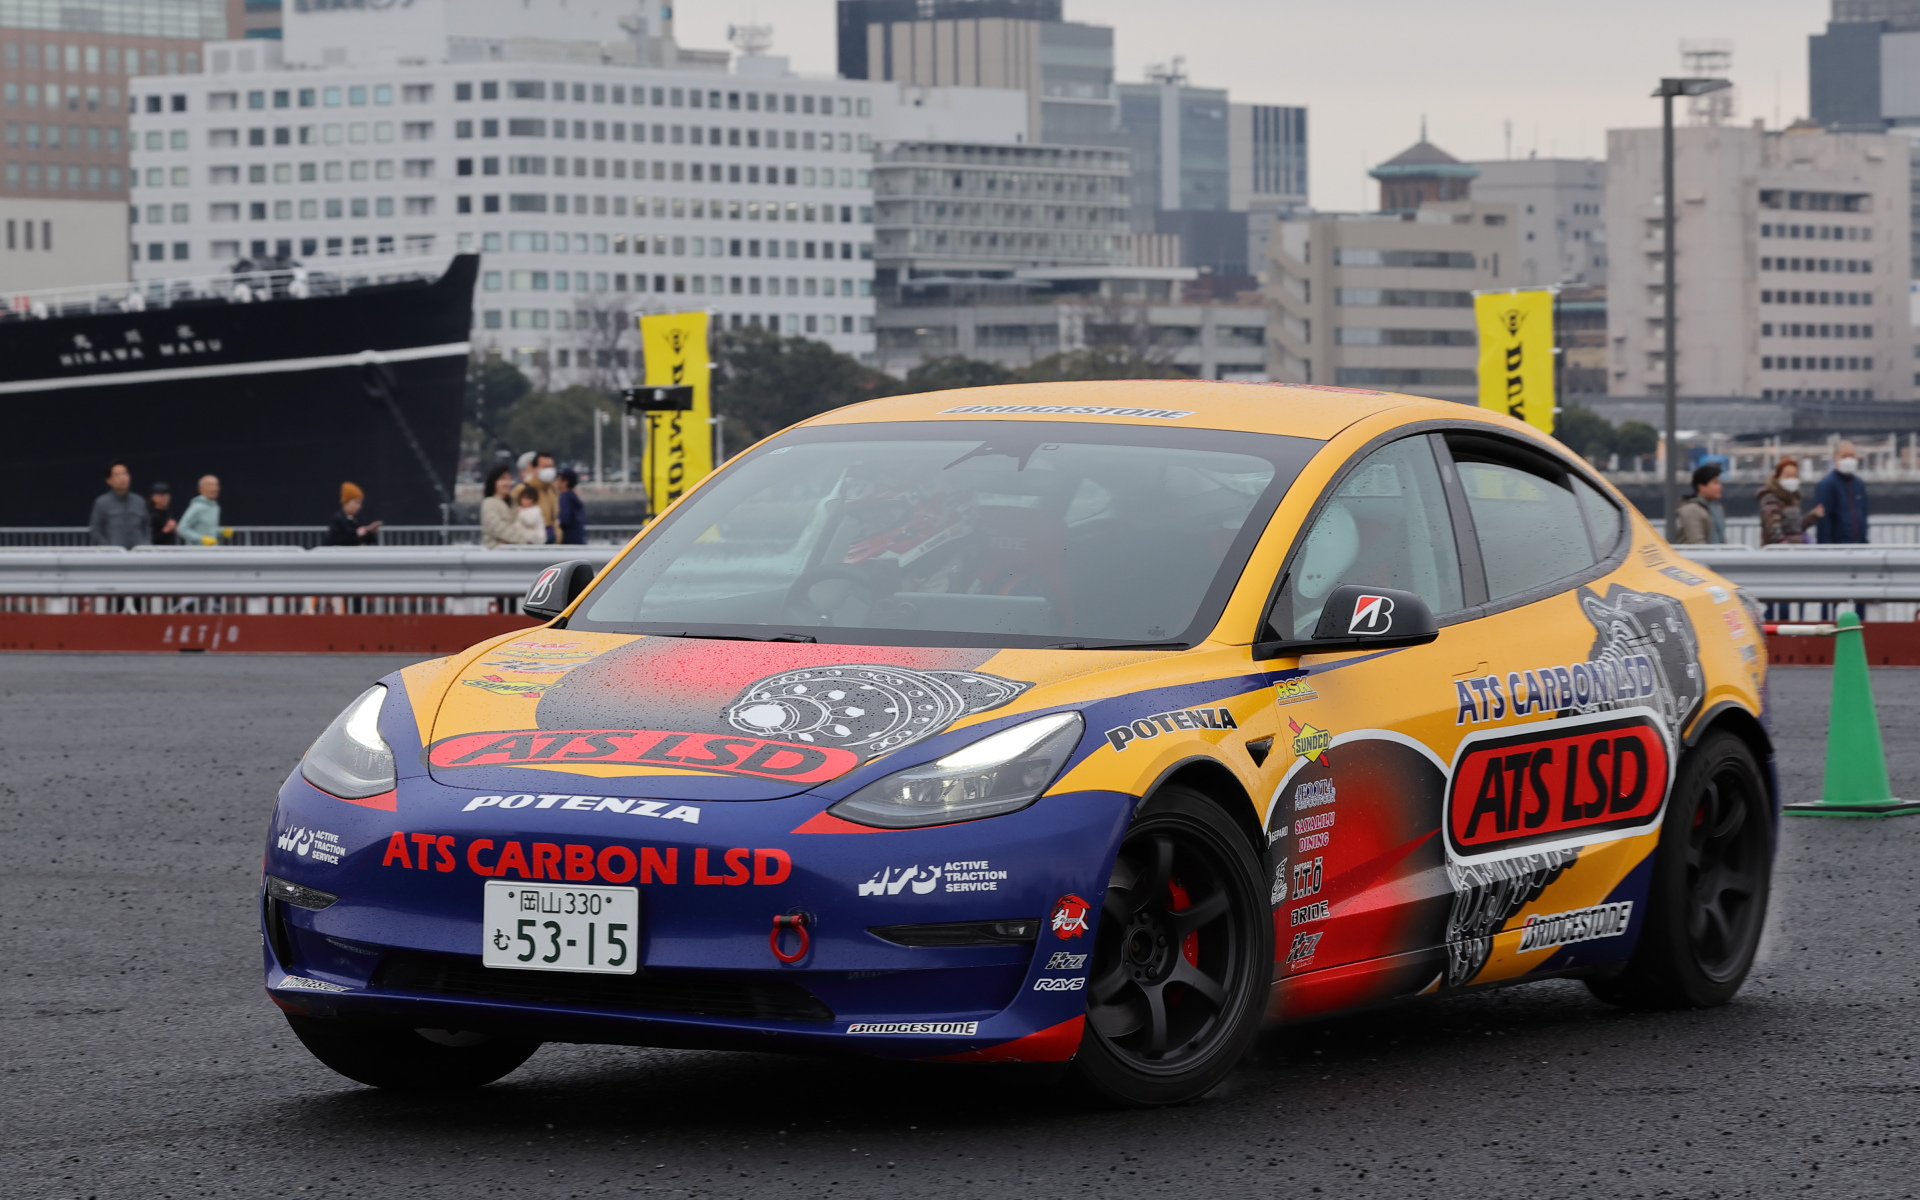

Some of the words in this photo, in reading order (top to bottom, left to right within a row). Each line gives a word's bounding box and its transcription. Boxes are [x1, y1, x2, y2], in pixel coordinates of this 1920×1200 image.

[946, 404, 1189, 419] BRIDGESTONE
[1273, 676, 1313, 698] RSK
[1454, 675, 1506, 726] ATS
[1508, 661, 1608, 717] CARBON
[1614, 655, 1655, 702] LSD
[1105, 708, 1239, 752] POTENZA
[450, 731, 635, 766] ATS
[637, 733, 829, 776] LSD
[1295, 732, 1330, 754] SUNOCO
[1463, 747, 1553, 840] ATS
[1561, 735, 1648, 823] LSD
[461, 794, 701, 825] POTENZA
[315, 830, 339, 843] ACTIVE
[1298, 832, 1330, 853] DINING
[311, 850, 339, 865] SERVICE
[314, 840, 346, 856] TRACTION
[382, 831, 456, 873] ATS
[467, 839, 678, 885] CARBON
[694, 847, 792, 886] LSD
[944, 860, 989, 871] ACTIVE
[944, 870, 1007, 882] TRACTION
[945, 881, 998, 893] SERVICE
[1051, 907, 1089, 931] 乱人
[1291, 900, 1330, 927] BRIDE
[1518, 902, 1630, 952] BRIDGESTONE
[493, 928, 511, 951] む
[517, 919, 628, 966] 53-15
[279, 975, 350, 992] BRIDGESTONE
[1033, 977, 1086, 991] RAYS
[849, 1022, 976, 1034] BRIDGESTONE
